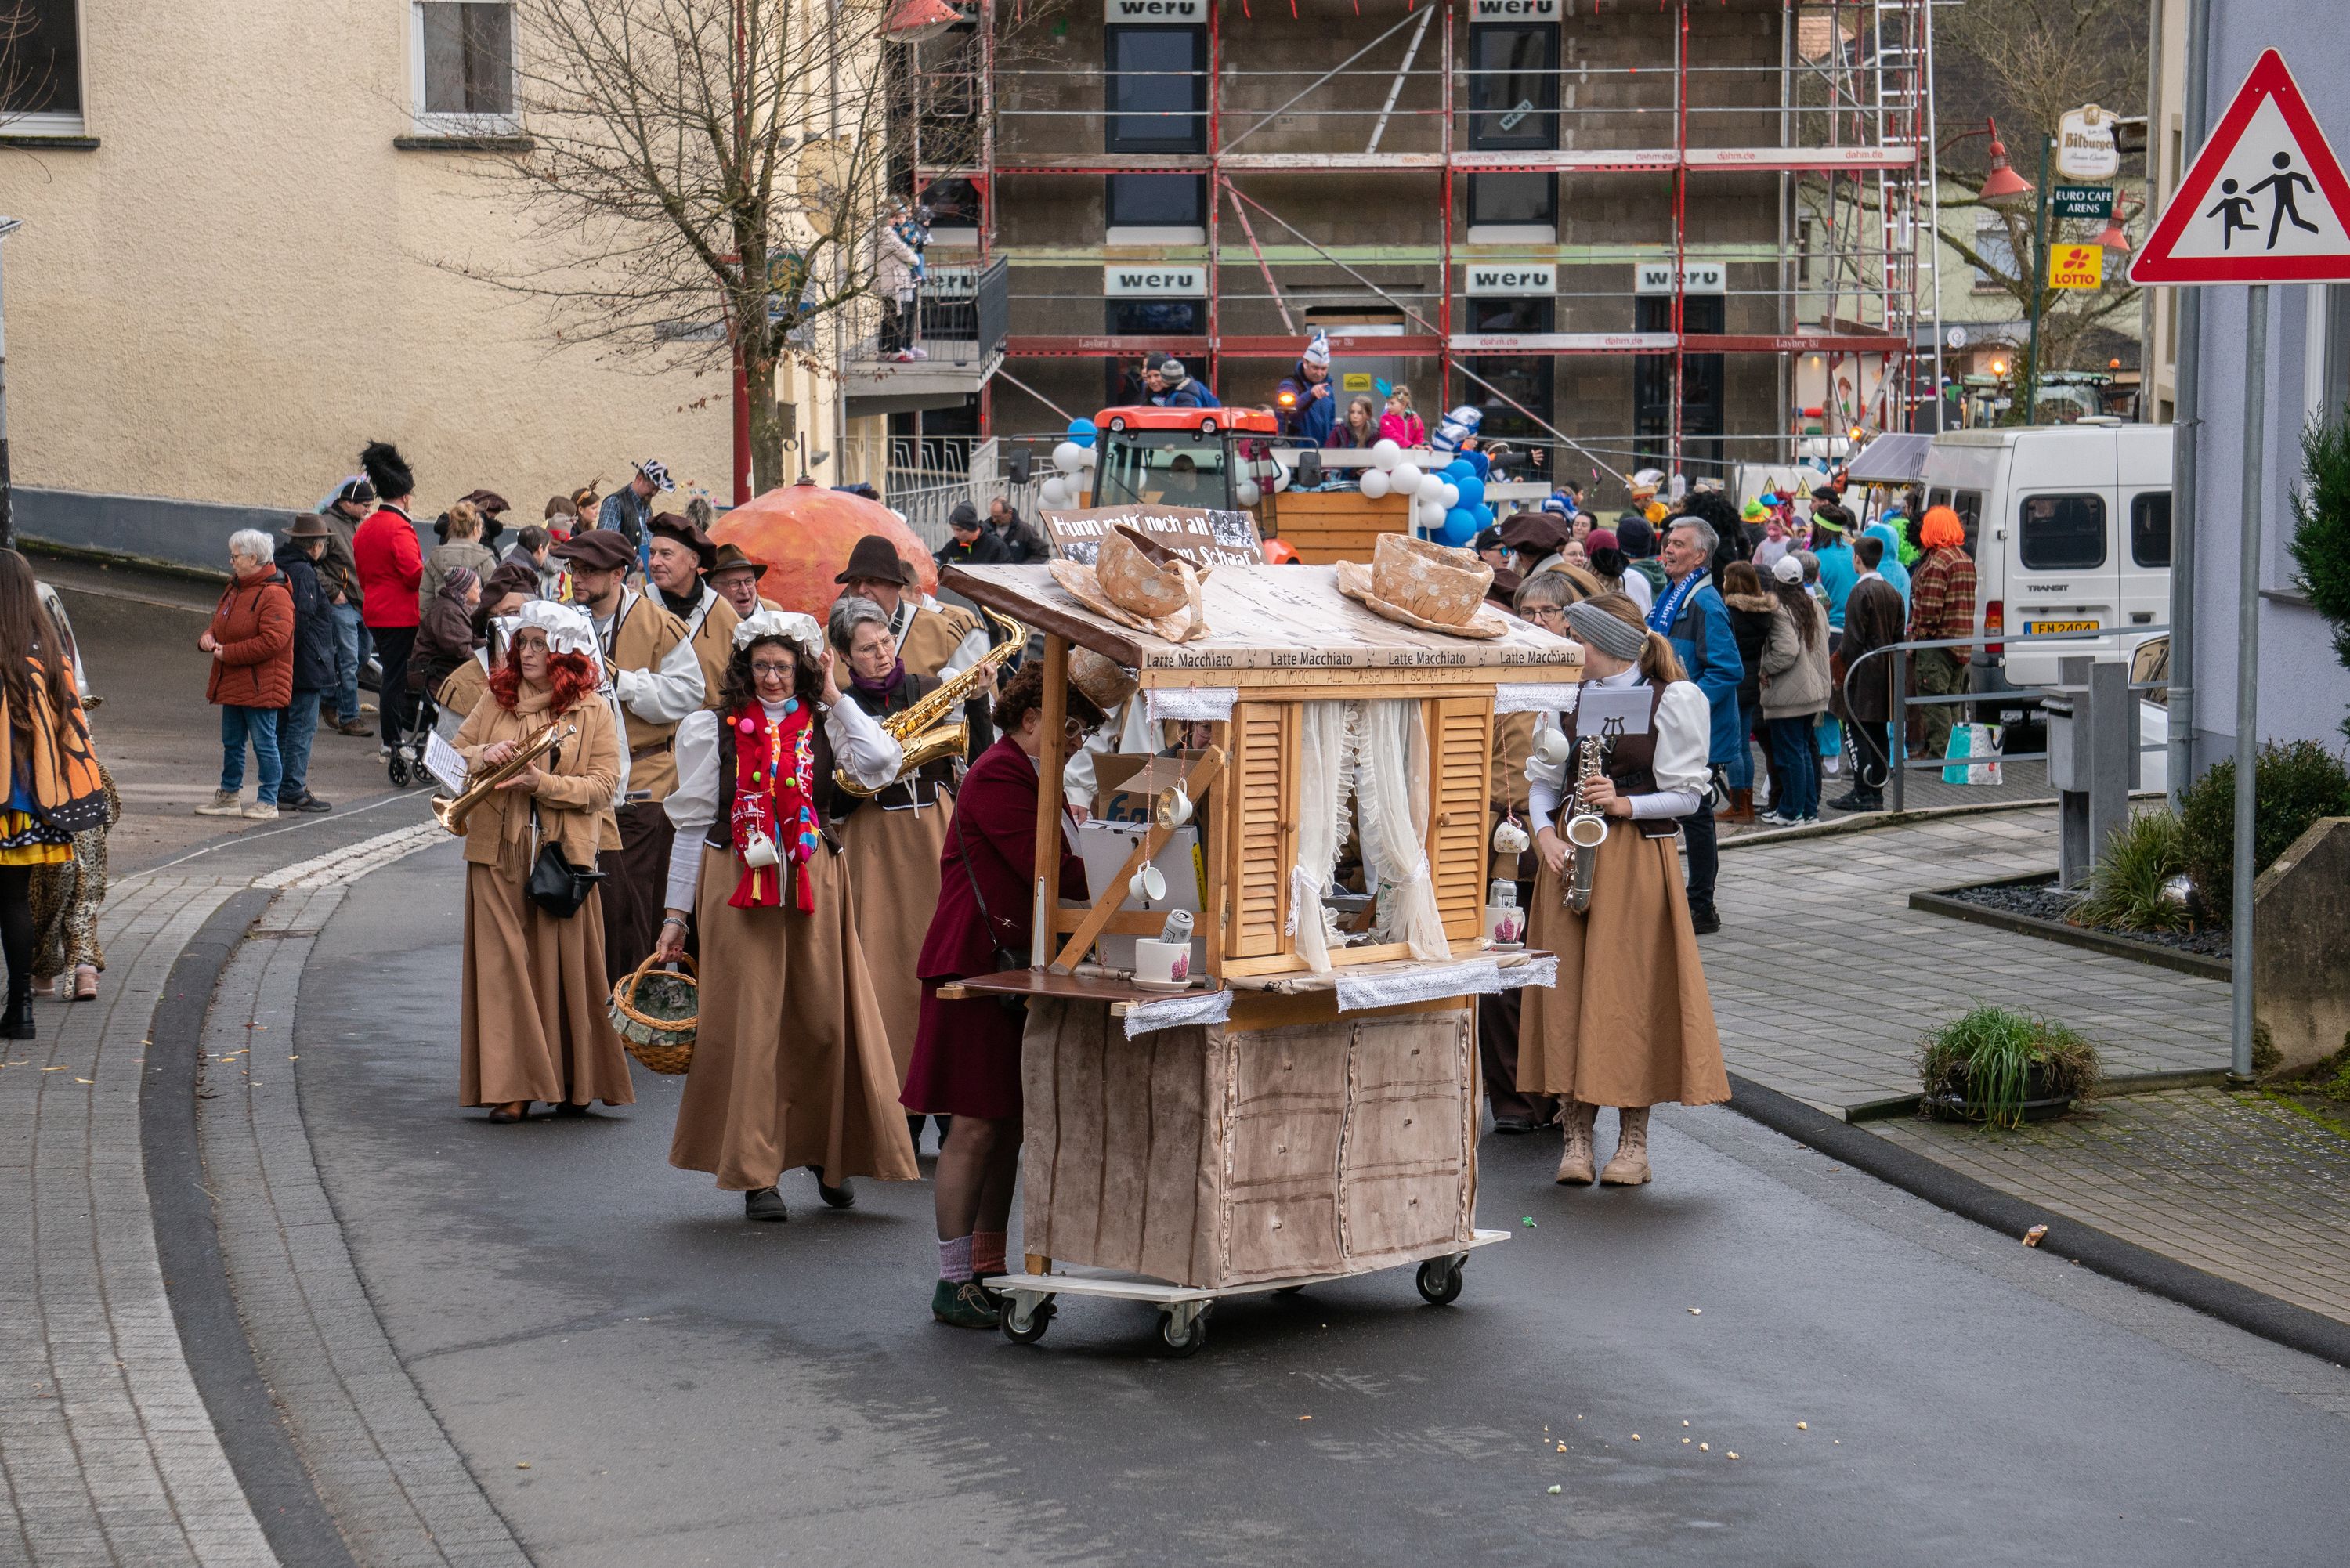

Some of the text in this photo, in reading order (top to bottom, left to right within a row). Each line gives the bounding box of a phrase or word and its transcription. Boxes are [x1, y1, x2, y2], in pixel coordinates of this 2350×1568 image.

[1121, 0, 1195, 15] weru
[1478, 0, 1553, 14] weru
[2065, 132, 2113, 151] Bitburger
[1716, 151, 1755, 161] dahm.de
[1845, 150, 1884, 159] dahm.de
[2055, 190, 2113, 201] EURO CAFE
[2066, 203, 2100, 213] ARENS
[1120, 273, 1193, 288] weru
[1474, 271, 1549, 287] weru
[2055, 273, 2095, 284] LOTTO
[1480, 337, 1518, 346] dahm.de
[1605, 335, 1643, 345] dahm.de
[1776, 338, 1807, 349] Layher
[1051, 515, 1104, 537] Hunn
[1145, 515, 1182, 533] noch
[1186, 516, 1209, 536] all
[1147, 653, 1173, 667] Latte
[1178, 652, 1233, 667] Macchiato
[1271, 652, 1296, 666] Latte
[1300, 651, 1353, 665] Macchiato
[1388, 651, 1413, 665] Latte
[1416, 651, 1466, 664] Macchiato
[1500, 651, 1524, 664] Latte
[1528, 650, 1575, 663] Macchiato
[1327, 670, 1343, 684] ALL
[1392, 669, 1405, 682] AM
